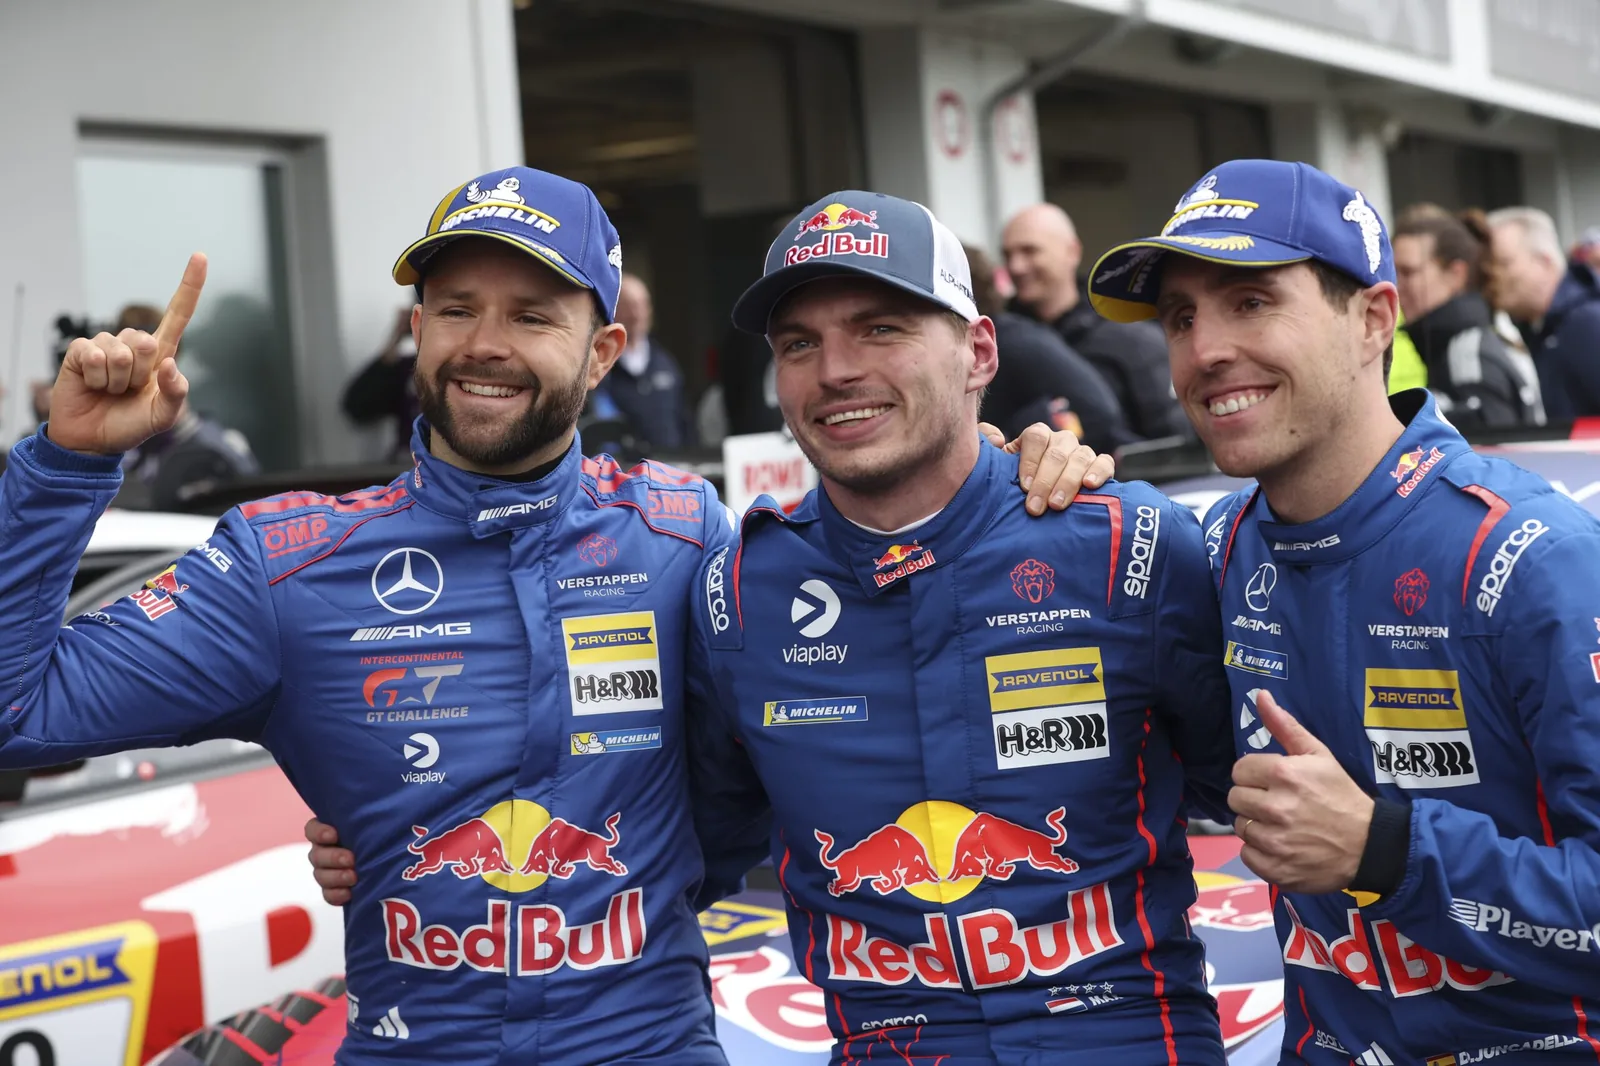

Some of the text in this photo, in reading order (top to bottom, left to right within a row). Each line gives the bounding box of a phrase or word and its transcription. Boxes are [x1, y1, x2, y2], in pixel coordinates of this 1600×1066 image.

[784, 232, 889, 267] Red Bull
[1396, 447, 1446, 498] Red Bull
[504, 494, 559, 516] AMG
[264, 518, 328, 551] OMP
[1291, 534, 1340, 551] AMG
[196, 543, 233, 573] MG
[1124, 505, 1160, 599] sparco
[873, 549, 937, 588] Red Bull
[1476, 519, 1549, 617] sparco
[556, 573, 649, 590] VERSTAPPEN
[584, 587, 626, 598] RACING
[986, 608, 1091, 627] VERSTAPPEN
[386, 622, 472, 640] AMG
[1016, 623, 1064, 635] RACING
[1248, 618, 1282, 636] AMG
[1368, 624, 1449, 639] VERSTAPPEN
[578, 630, 646, 646] RAVENOL
[1391, 639, 1430, 651] RACING
[360, 651, 464, 665] INTERCONTINENTAL
[782, 642, 848, 665] viaplay
[1002, 669, 1090, 687] RAVENOL
[574, 671, 634, 704] H&R
[1378, 691, 1450, 705] RAVENOL
[366, 706, 469, 723] GT CHALLENGE
[790, 704, 857, 718] MICHELIN
[605, 732, 660, 746] MICHELIN
[997, 718, 1072, 758] H&R
[1371, 741, 1435, 777] H&R
[401, 770, 446, 785] viaplay
[379, 898, 511, 976] Red
[517, 887, 647, 977] Bull
[1475, 902, 1600, 952] Player
[827, 881, 1124, 992] Red Bull
